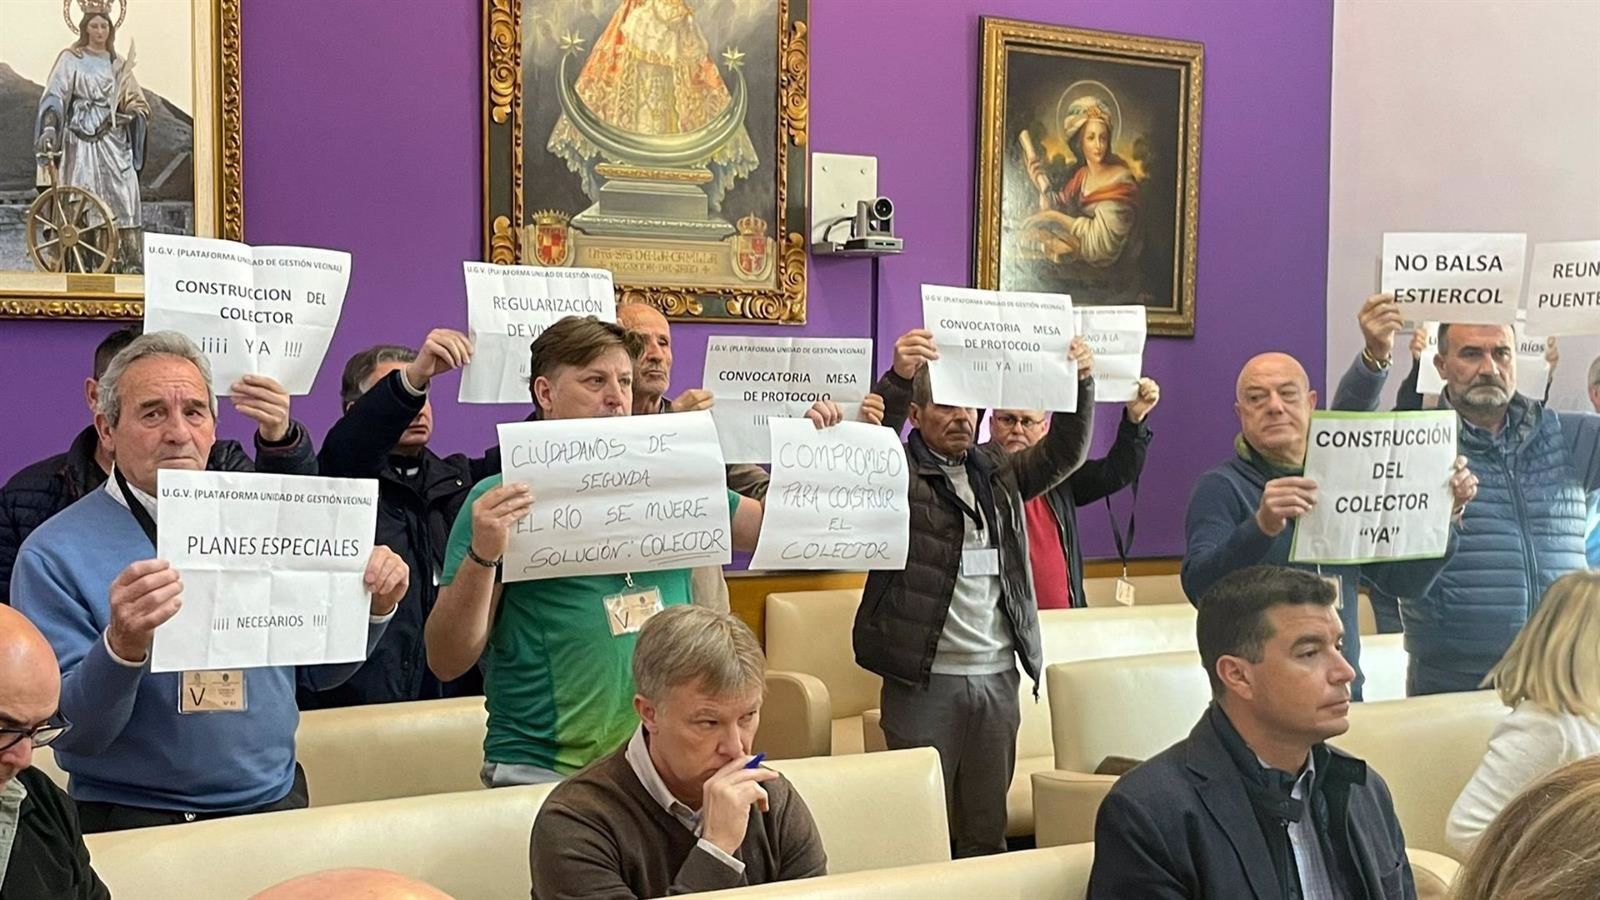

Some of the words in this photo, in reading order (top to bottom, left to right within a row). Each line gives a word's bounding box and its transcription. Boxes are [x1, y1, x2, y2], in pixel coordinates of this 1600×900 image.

[149, 246, 175, 256] U.G.V.
[177, 248, 235, 262] (PLATAFORMA
[266, 258, 276, 267] DE
[279, 259, 311, 269] GESTIÓN
[1395, 255, 1428, 271] NO
[1436, 255, 1503, 272] BALSA
[1553, 261, 1600, 279] REUN
[175, 279, 292, 301] CONSTRUCCION
[307, 291, 326, 305] DEL
[1393, 288, 1503, 304] ESTIERCOL
[493, 296, 603, 313] REGULARIZACIÓN
[220, 306, 293, 324] COLECTOR
[507, 323, 525, 337] DE
[940, 319, 1021, 334] CONVOCATORIA
[1033, 325, 1061, 337] MESA
[964, 338, 978, 349] DE
[981, 339, 1040, 352] PROTOCOLO
[719, 370, 811, 383] CONVOCATORIA
[826, 373, 857, 384] MESA
[743, 391, 757, 402] DE
[761, 391, 831, 402] PROTOCOLO
[648, 433, 678, 454] DE
[1316, 422, 1451, 448] CONSTRUCCIÓN
[1372, 462, 1404, 479] DEL
[576, 469, 651, 493] SEGUNDA
[162, 488, 192, 498] U.G.V.
[194, 489, 259, 502] (PLATAFORMA
[260, 492, 292, 502] UNIDAD
[294, 494, 304, 503] DE
[307, 493, 341, 505] GESTIÓN
[782, 481, 820, 512] PARA
[1335, 493, 1428, 513] COLECTOR
[516, 515, 544, 534] EL
[552, 504, 582, 530] RÍO
[605, 504, 634, 525] SE
[645, 497, 709, 520] MUERE
[828, 517, 852, 531] EL
[187, 535, 257, 555] PLANES
[261, 536, 359, 557] ESPECIALES
[640, 528, 728, 558] COLECTOR
[781, 541, 890, 560] COLECTOR
[237, 615, 304, 629] NECESARIOS
[614, 611, 629, 629] V
[190, 687, 205, 706] V
